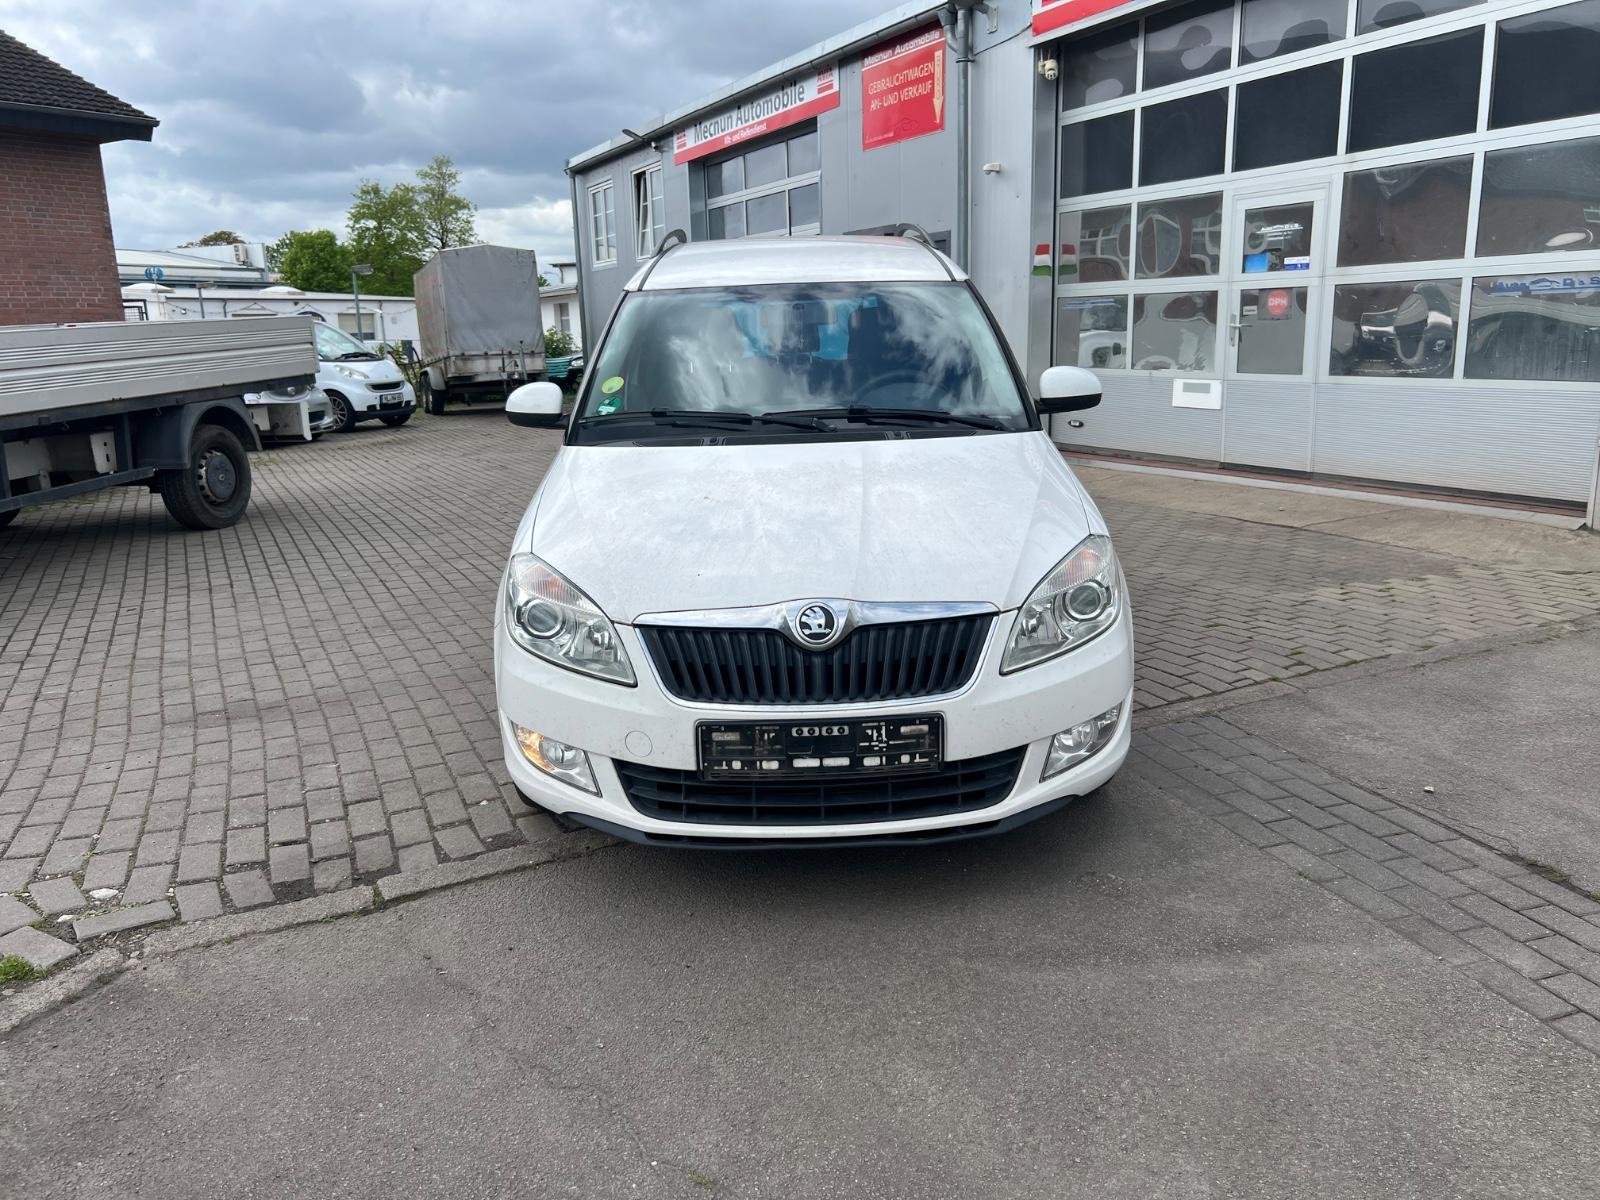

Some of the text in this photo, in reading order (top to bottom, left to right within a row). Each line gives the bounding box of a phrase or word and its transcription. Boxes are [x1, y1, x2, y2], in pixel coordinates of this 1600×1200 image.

[894, 30, 940, 56] Automobile
[868, 61, 935, 95] GEBRAUCHTWAGEN
[883, 91, 899, 107] UND
[900, 80, 933, 102] VERKAUF
[694, 113, 733, 144] Mecnun
[735, 79, 805, 126] Automobile
